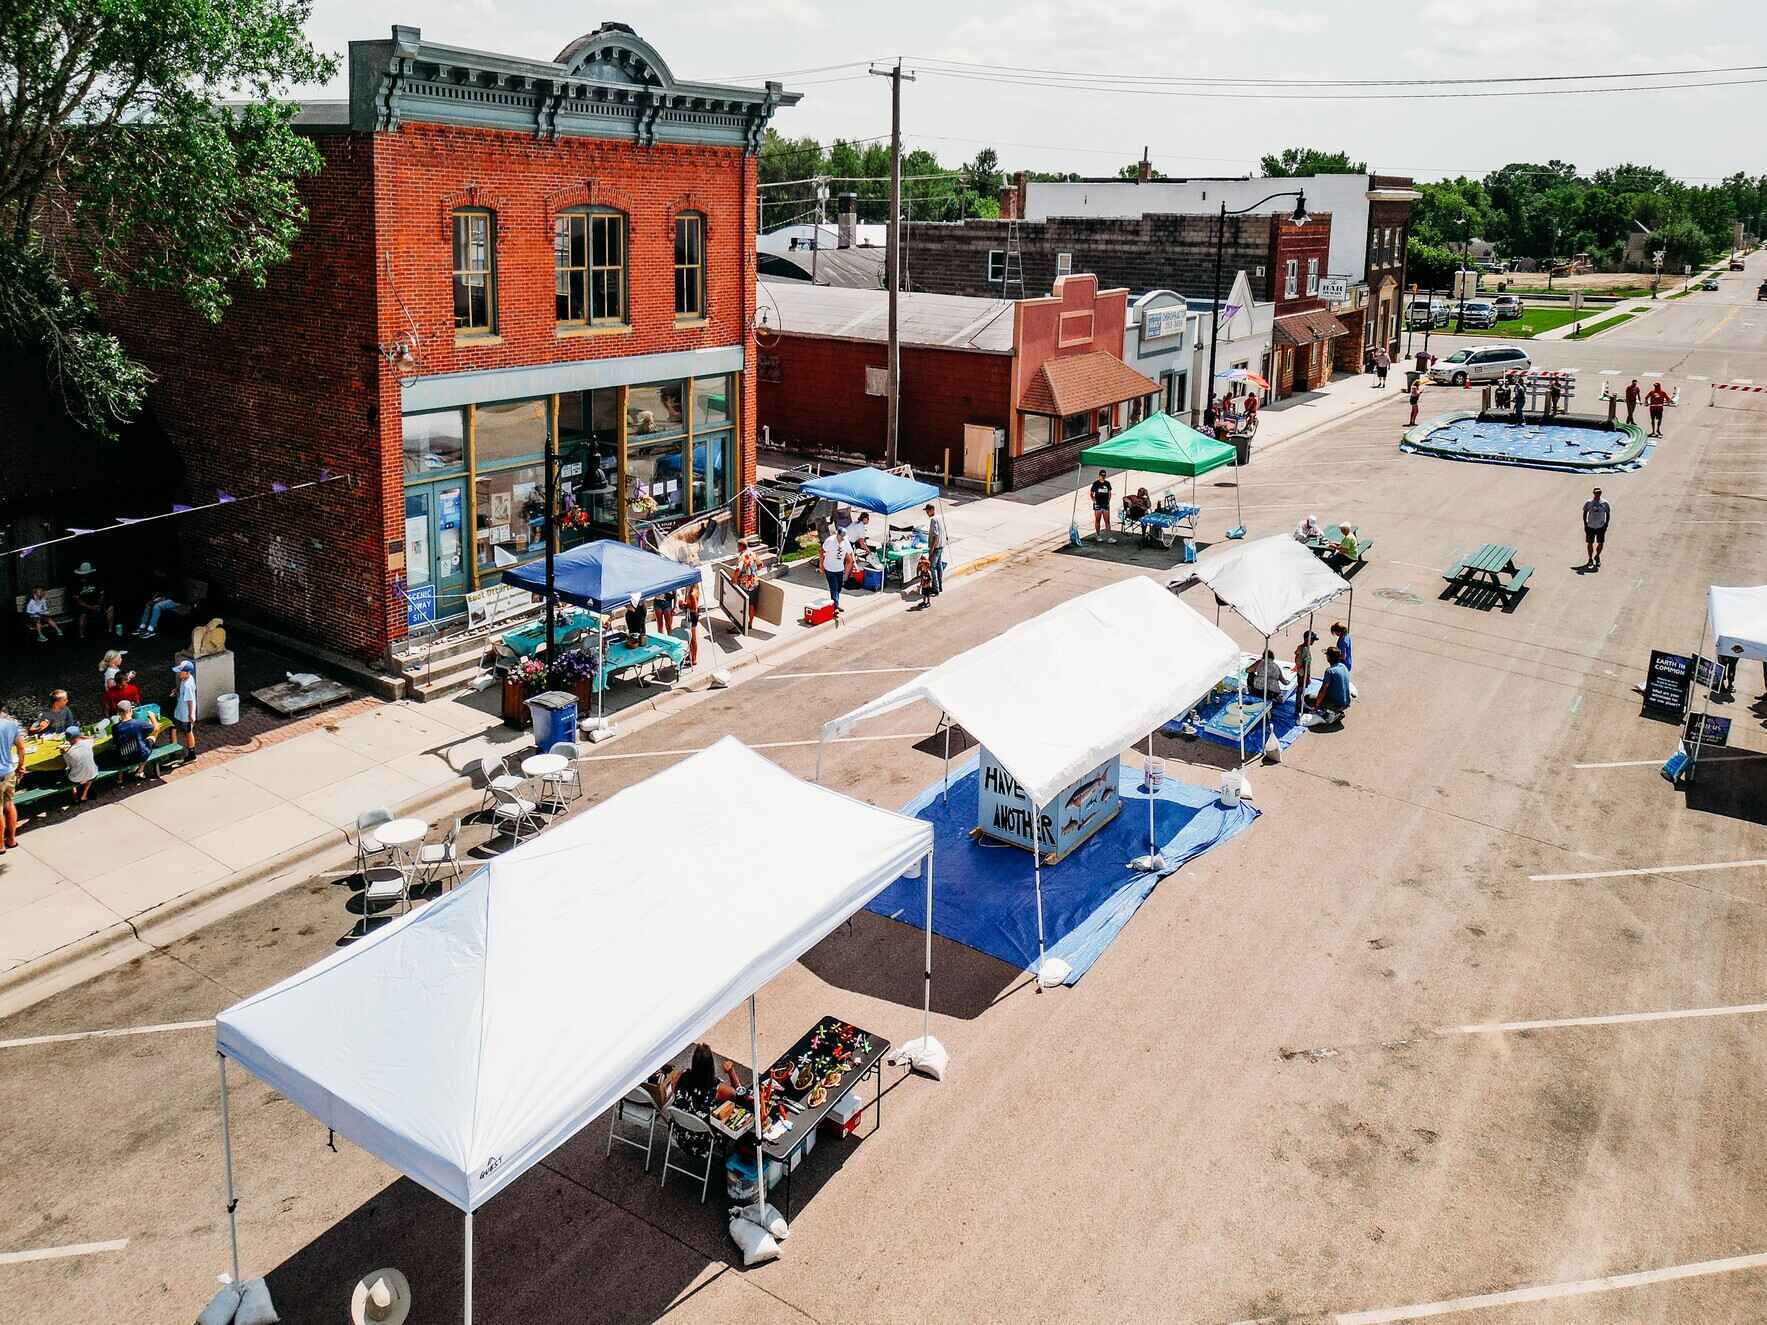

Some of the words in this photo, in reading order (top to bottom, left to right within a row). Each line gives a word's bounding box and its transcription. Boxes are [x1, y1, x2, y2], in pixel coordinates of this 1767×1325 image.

[407, 589, 432, 601] SCENIC
[1655, 658, 1677, 668] EARTH
[1654, 664, 1686, 676] COMMON
[984, 766, 1026, 801] HAVE
